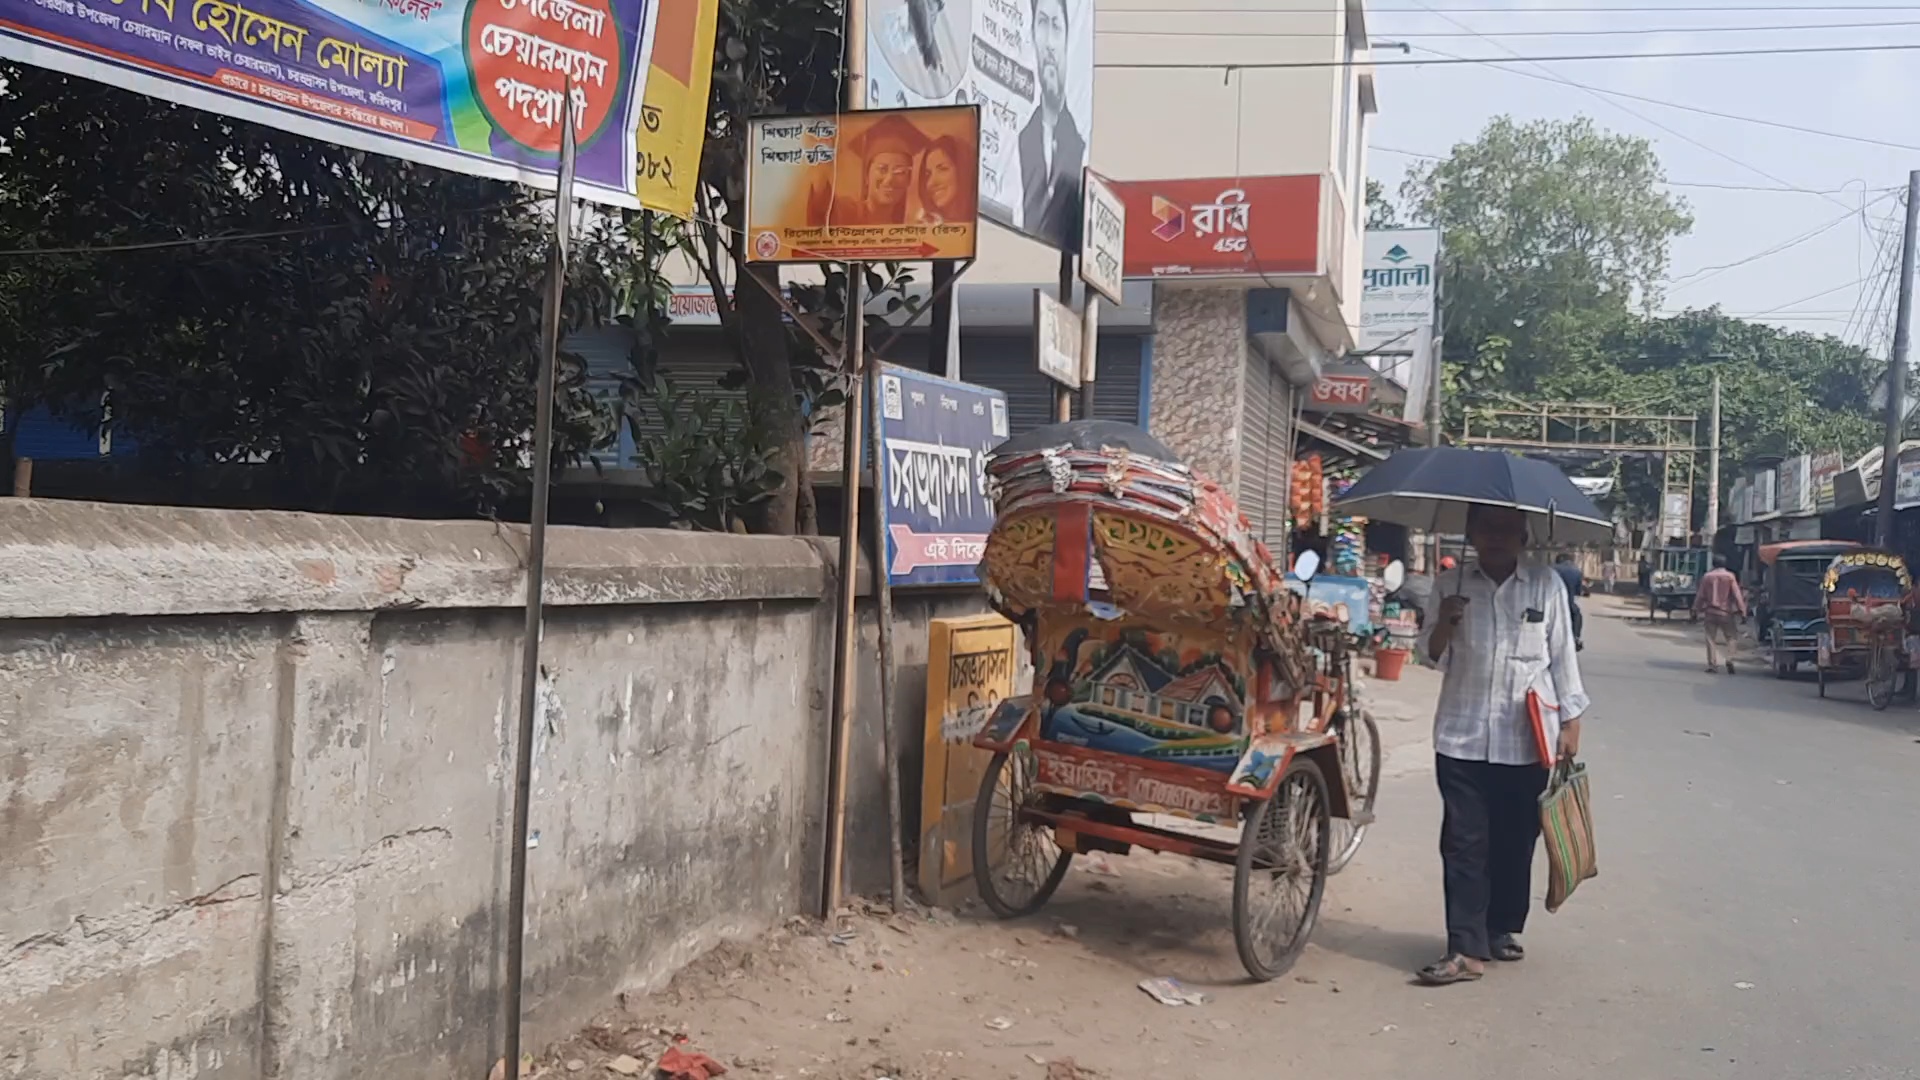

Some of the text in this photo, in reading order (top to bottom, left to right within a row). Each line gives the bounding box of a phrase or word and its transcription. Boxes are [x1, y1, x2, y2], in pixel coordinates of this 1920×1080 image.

[76, 1, 120, 30] উপজেলা
[122, 19, 173, 46] চেয়ারম্যান
[191, 0, 409, 92] হোসেন মোল্যা
[480, 22, 609, 88] চেয়ারম্যান
[761, 120, 836, 141] শিক্ষাই শক্তি
[761, 146, 803, 165] শিক্ষাই
[1190, 188, 1252, 238] রবি
[1362, 264, 1430, 291] পূবালী
[885, 432, 973, 527] চরভদ্রাসন
[923, 537, 949, 561] এই
[951, 645, 1009, 690] চরভদ্রাসন
